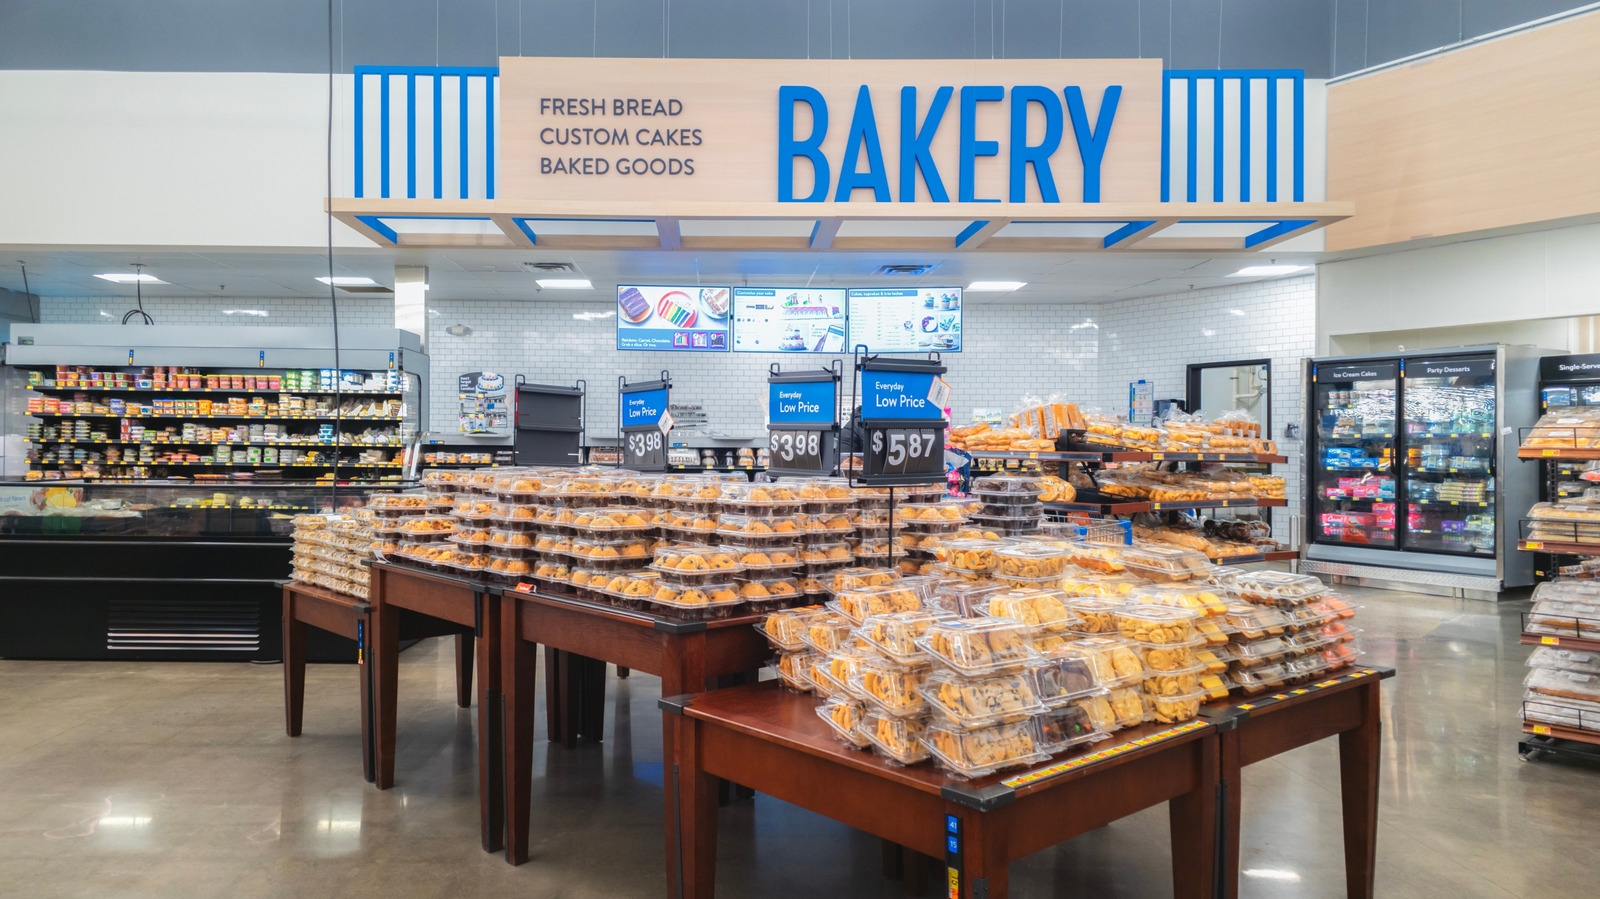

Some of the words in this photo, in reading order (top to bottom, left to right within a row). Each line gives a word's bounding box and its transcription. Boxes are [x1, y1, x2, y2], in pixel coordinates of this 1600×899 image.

[540, 98, 605, 116] FRESH
[613, 98, 683, 116] BREAD
[540, 127, 629, 145] CUSTOM
[635, 128, 703, 146] CAKES
[778, 84, 1123, 203] BAKERY
[540, 157, 609, 175] BAKED
[616, 157, 695, 176] GOODS
[875, 381, 905, 392] Everyday
[779, 391, 802, 400] Everyday
[876, 393, 897, 407] Low
[899, 394, 926, 408] Price
[629, 409, 641, 418] Low
[641, 406, 657, 417] Price
[779, 401, 797, 413] Low
[798, 401, 820, 413] Price
[950, 821, 957, 829] 41
[950, 840, 957, 848] 15
